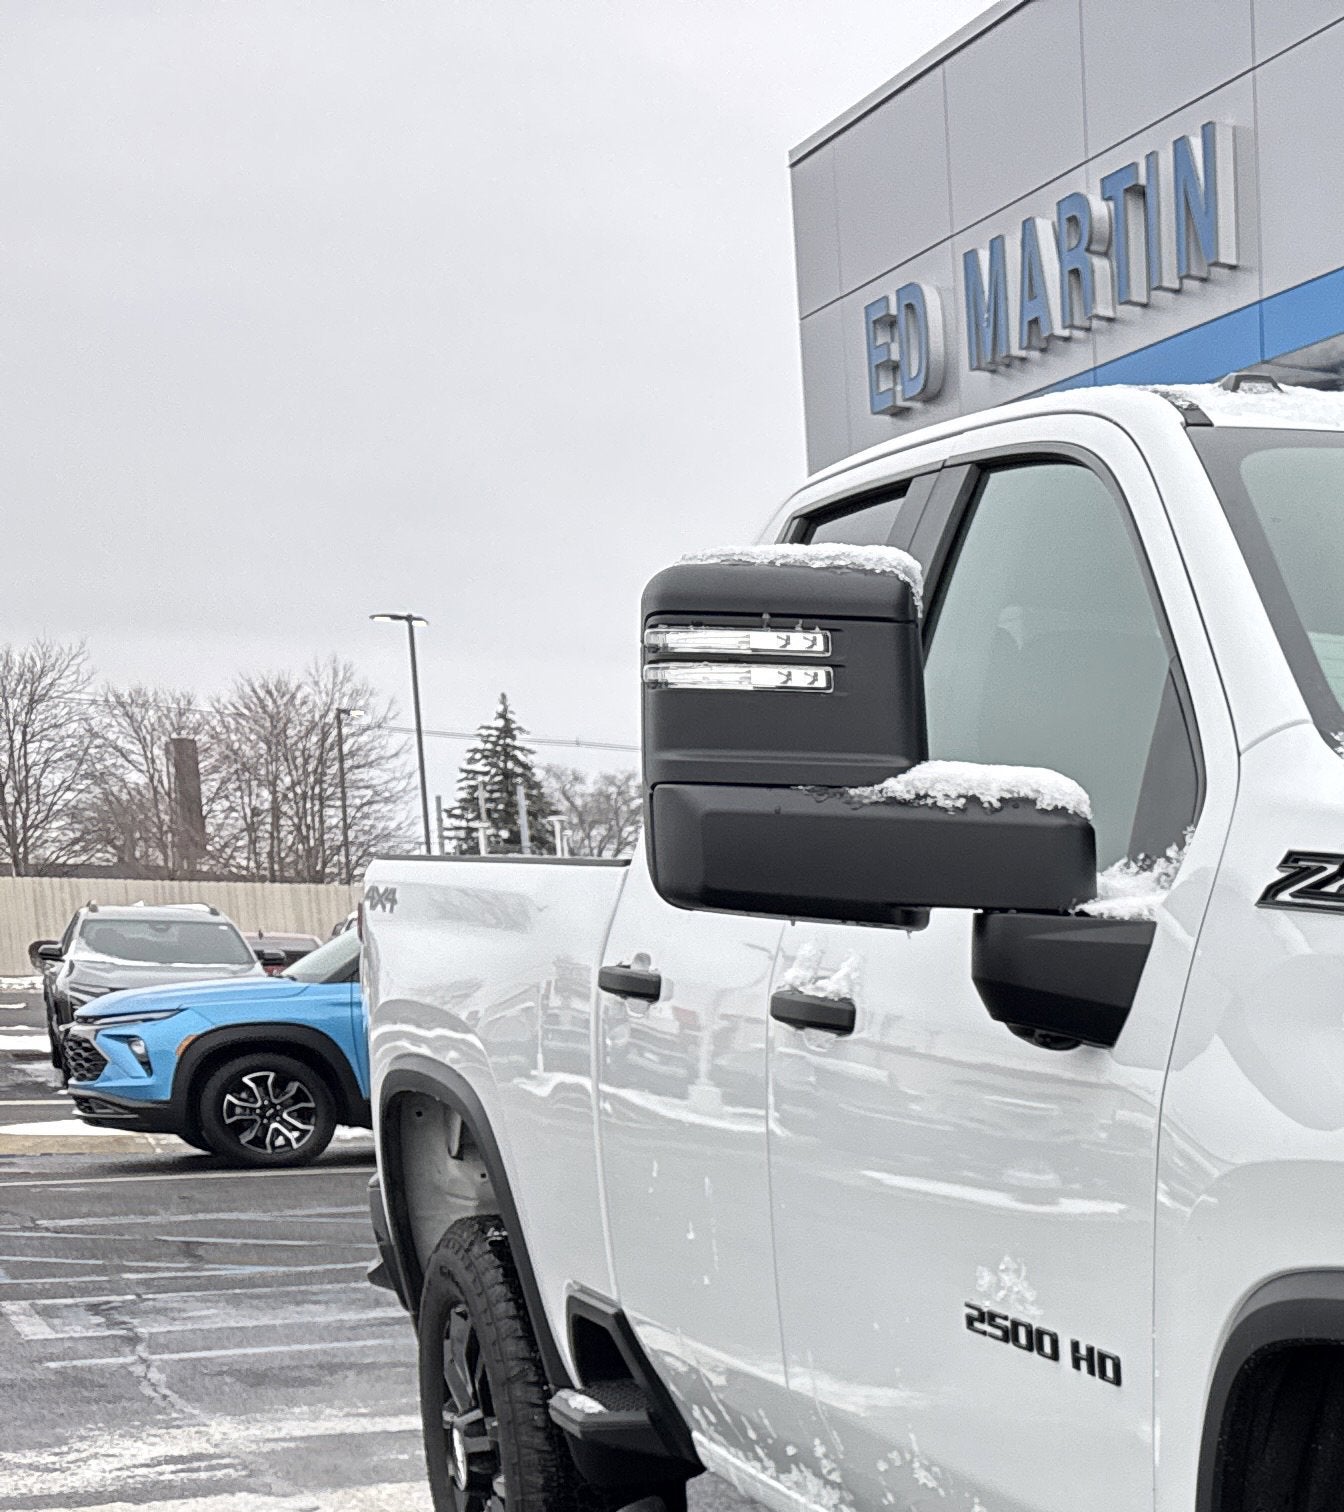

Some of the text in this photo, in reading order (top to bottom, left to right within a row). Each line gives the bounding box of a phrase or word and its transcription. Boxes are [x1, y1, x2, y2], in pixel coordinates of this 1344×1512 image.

[864, 120, 1237, 417] ED MARTIN
[964, 1301, 1122, 1387] 2500 HD
